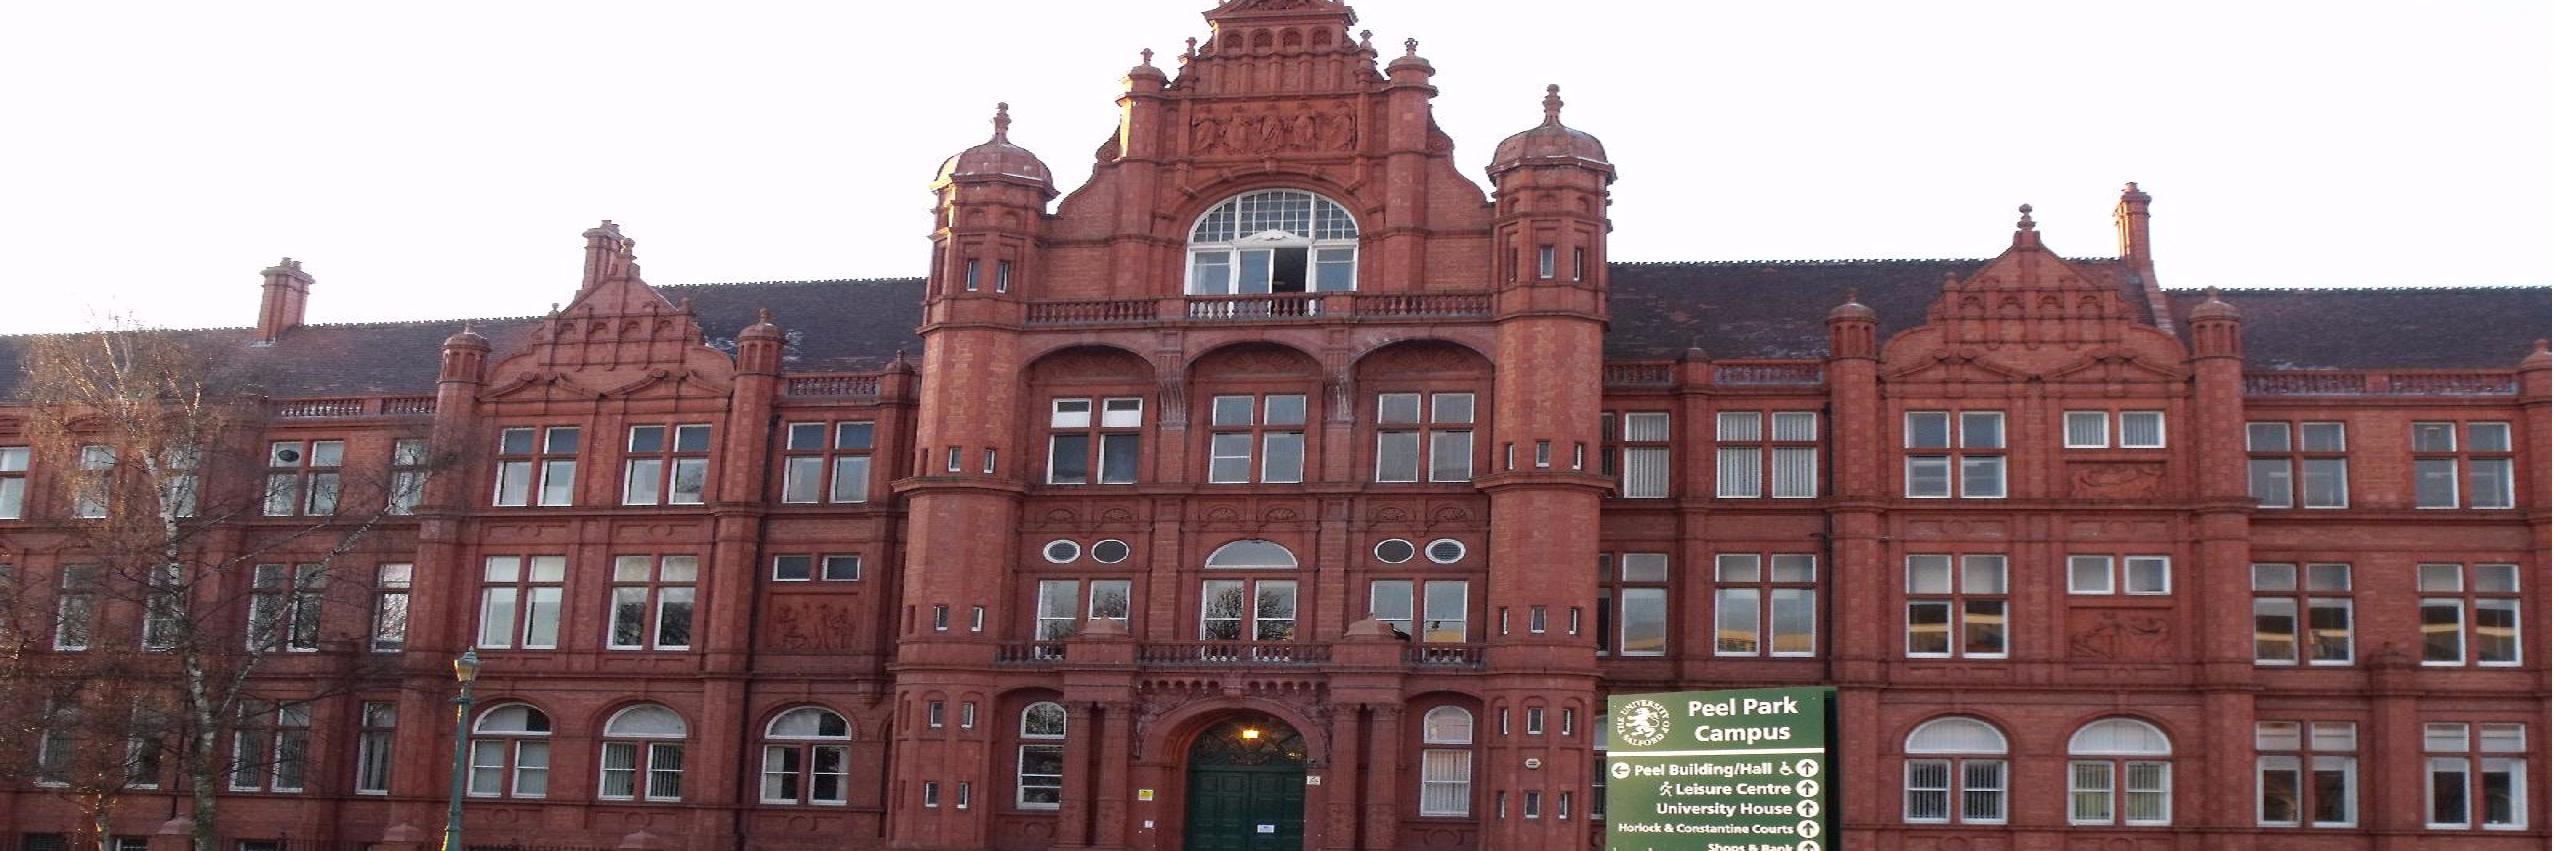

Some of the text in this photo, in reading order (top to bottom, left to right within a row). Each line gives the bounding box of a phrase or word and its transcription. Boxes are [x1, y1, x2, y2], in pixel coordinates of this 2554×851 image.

[1688, 696, 1799, 717] Peel Park
[1694, 725, 1791, 745] Campus
[1634, 762, 1773, 777] Peel Building/Hall
[1676, 783, 1791, 795] Leisure Centre
[1656, 802, 1793, 817] University House
[1618, 823, 1794, 834] Horlock & Constantine Courts
[1708, 843, 1745, 851] Shops
